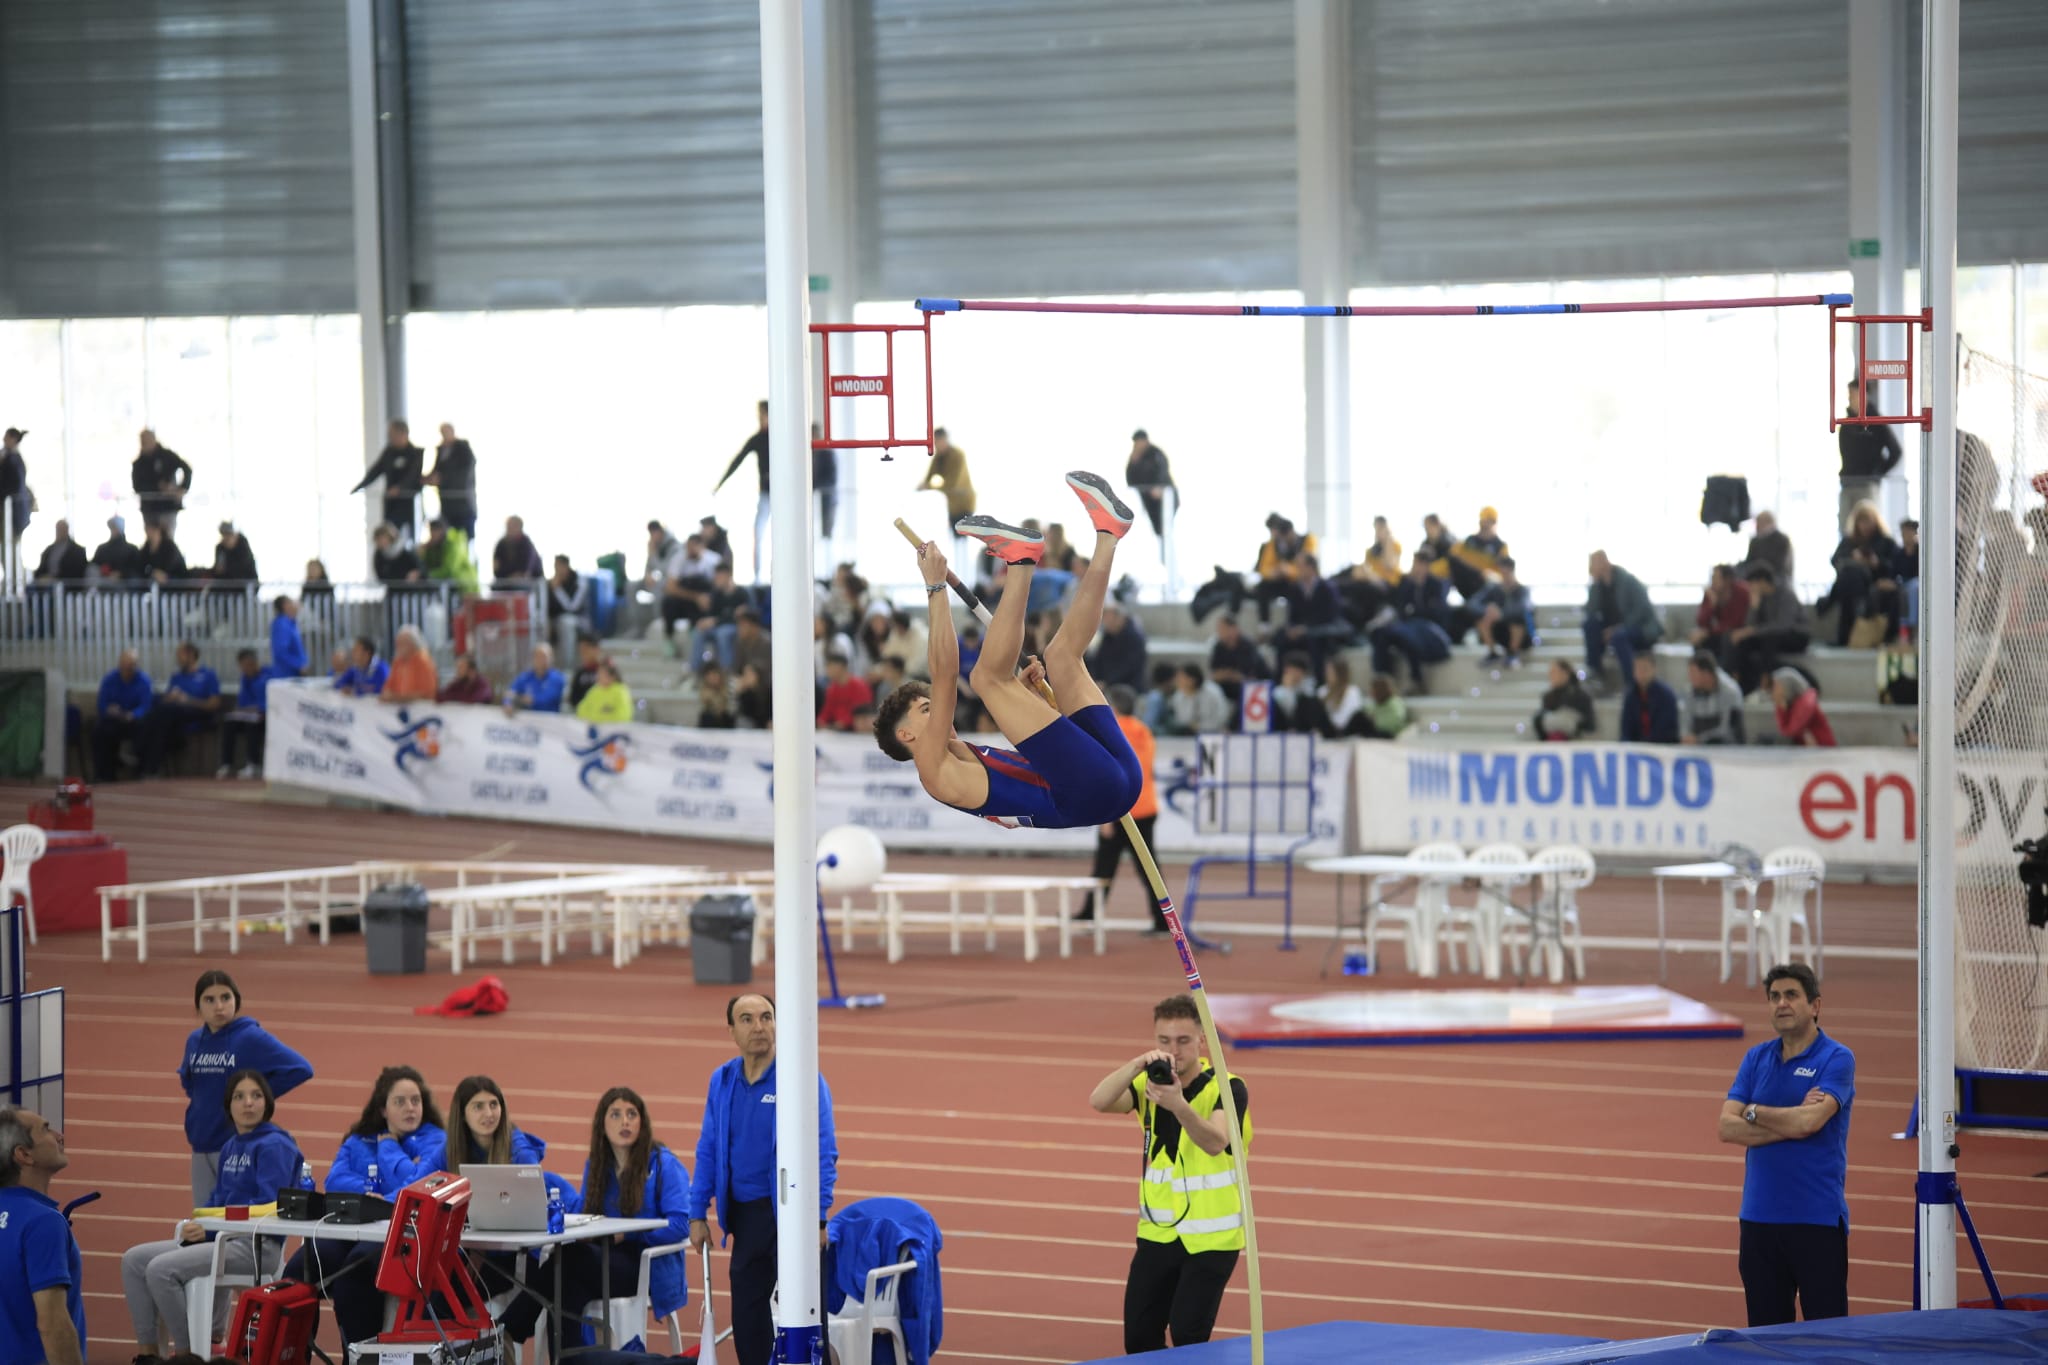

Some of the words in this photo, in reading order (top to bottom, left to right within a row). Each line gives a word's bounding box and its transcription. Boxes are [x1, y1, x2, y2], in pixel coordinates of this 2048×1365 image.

[1874, 363, 1906, 376] MONDO
[842, 379, 884, 392] MONDO
[1244, 683, 1269, 723] 6
[1459, 752, 1715, 809] MONDO
